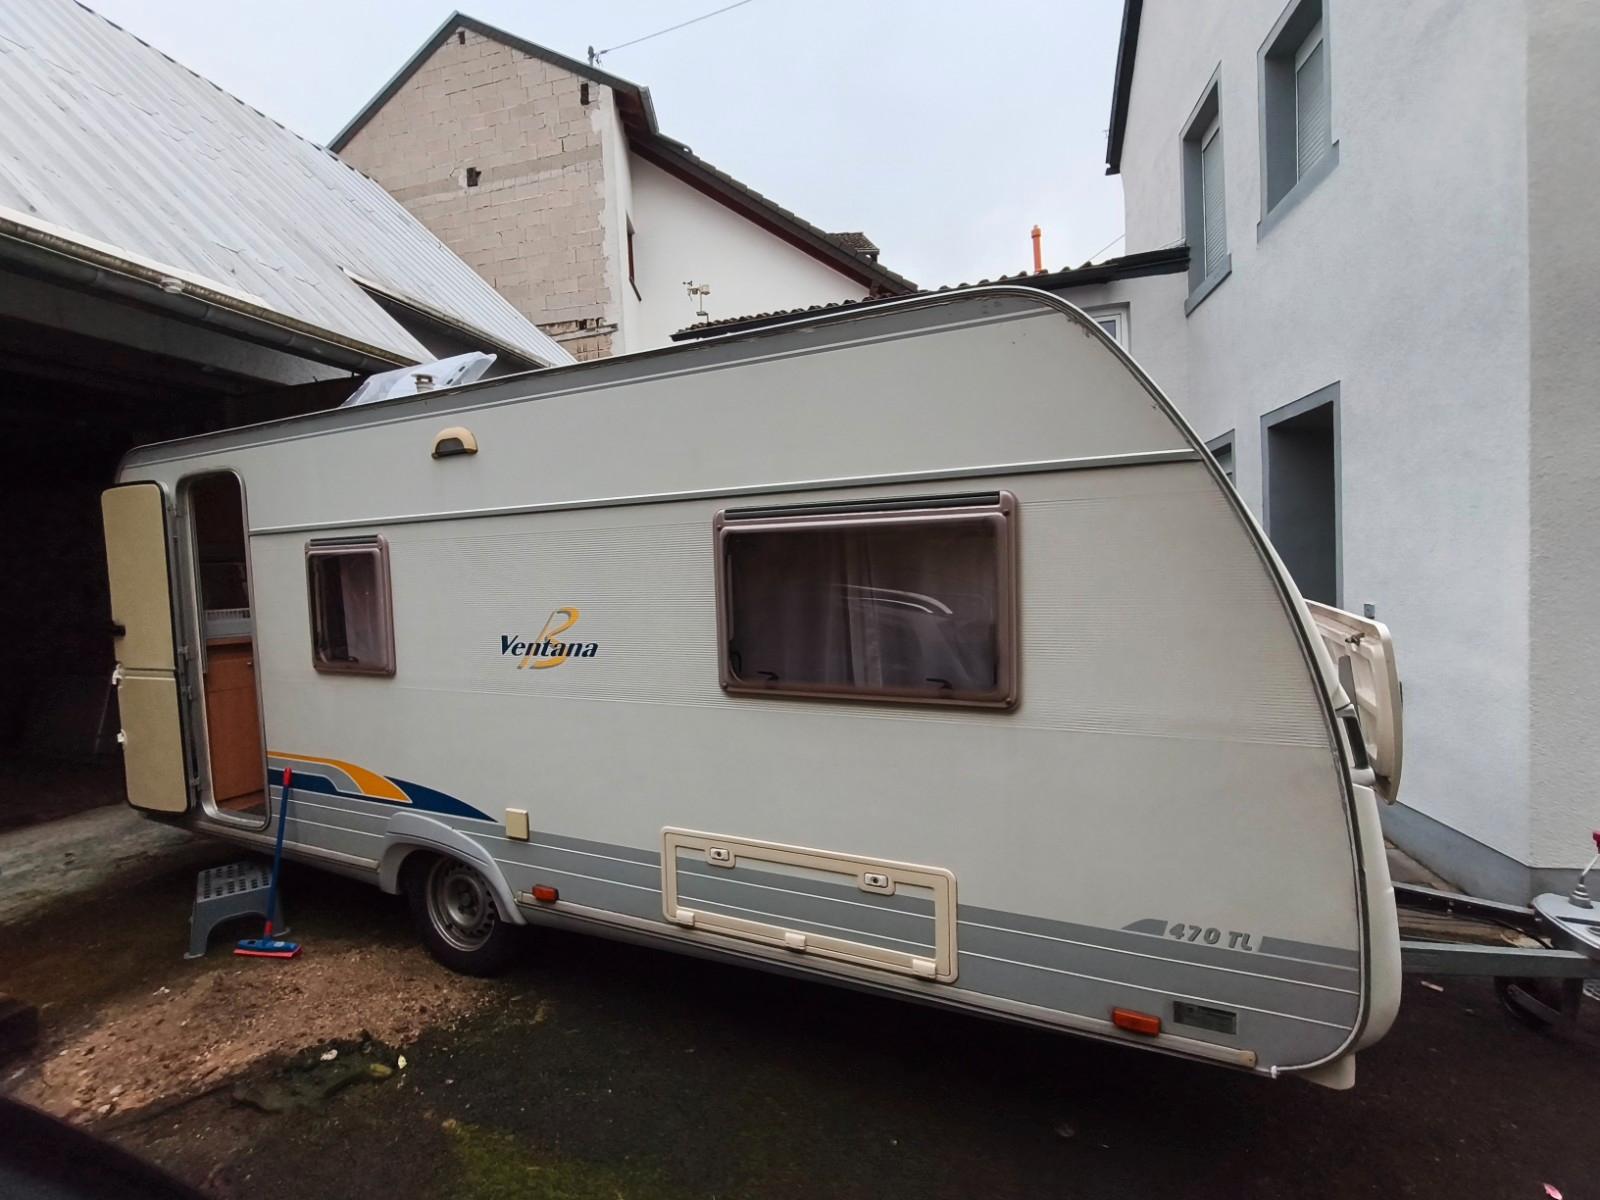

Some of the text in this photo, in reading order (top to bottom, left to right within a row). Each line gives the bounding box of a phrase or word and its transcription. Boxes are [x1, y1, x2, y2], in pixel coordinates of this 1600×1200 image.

[501, 634, 599, 657] Ventana
[1169, 923, 1253, 951] 470 TL
